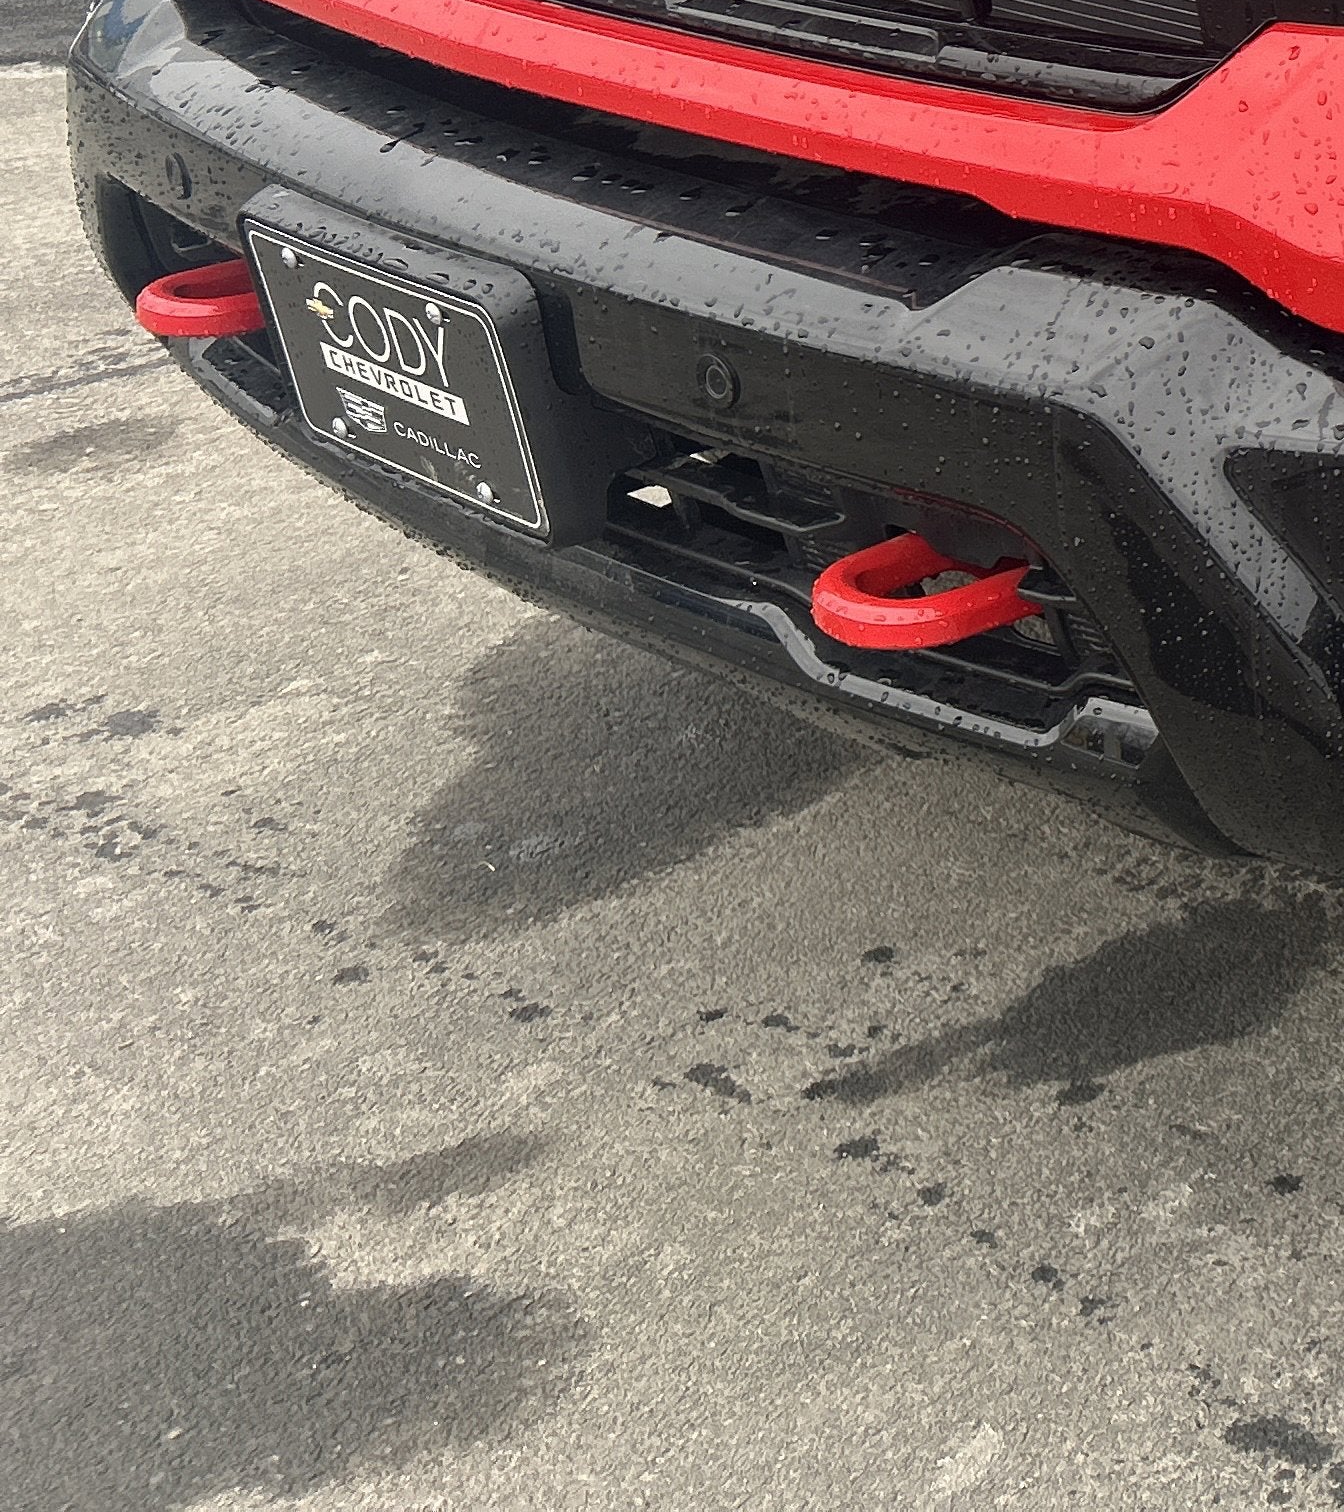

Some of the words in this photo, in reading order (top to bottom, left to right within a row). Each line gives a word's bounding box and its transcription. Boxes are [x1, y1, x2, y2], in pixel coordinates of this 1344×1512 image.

[312, 281, 450, 388] CODY
[326, 347, 465, 416] CHEVROLET
[392, 420, 482, 470] CADILLAC
